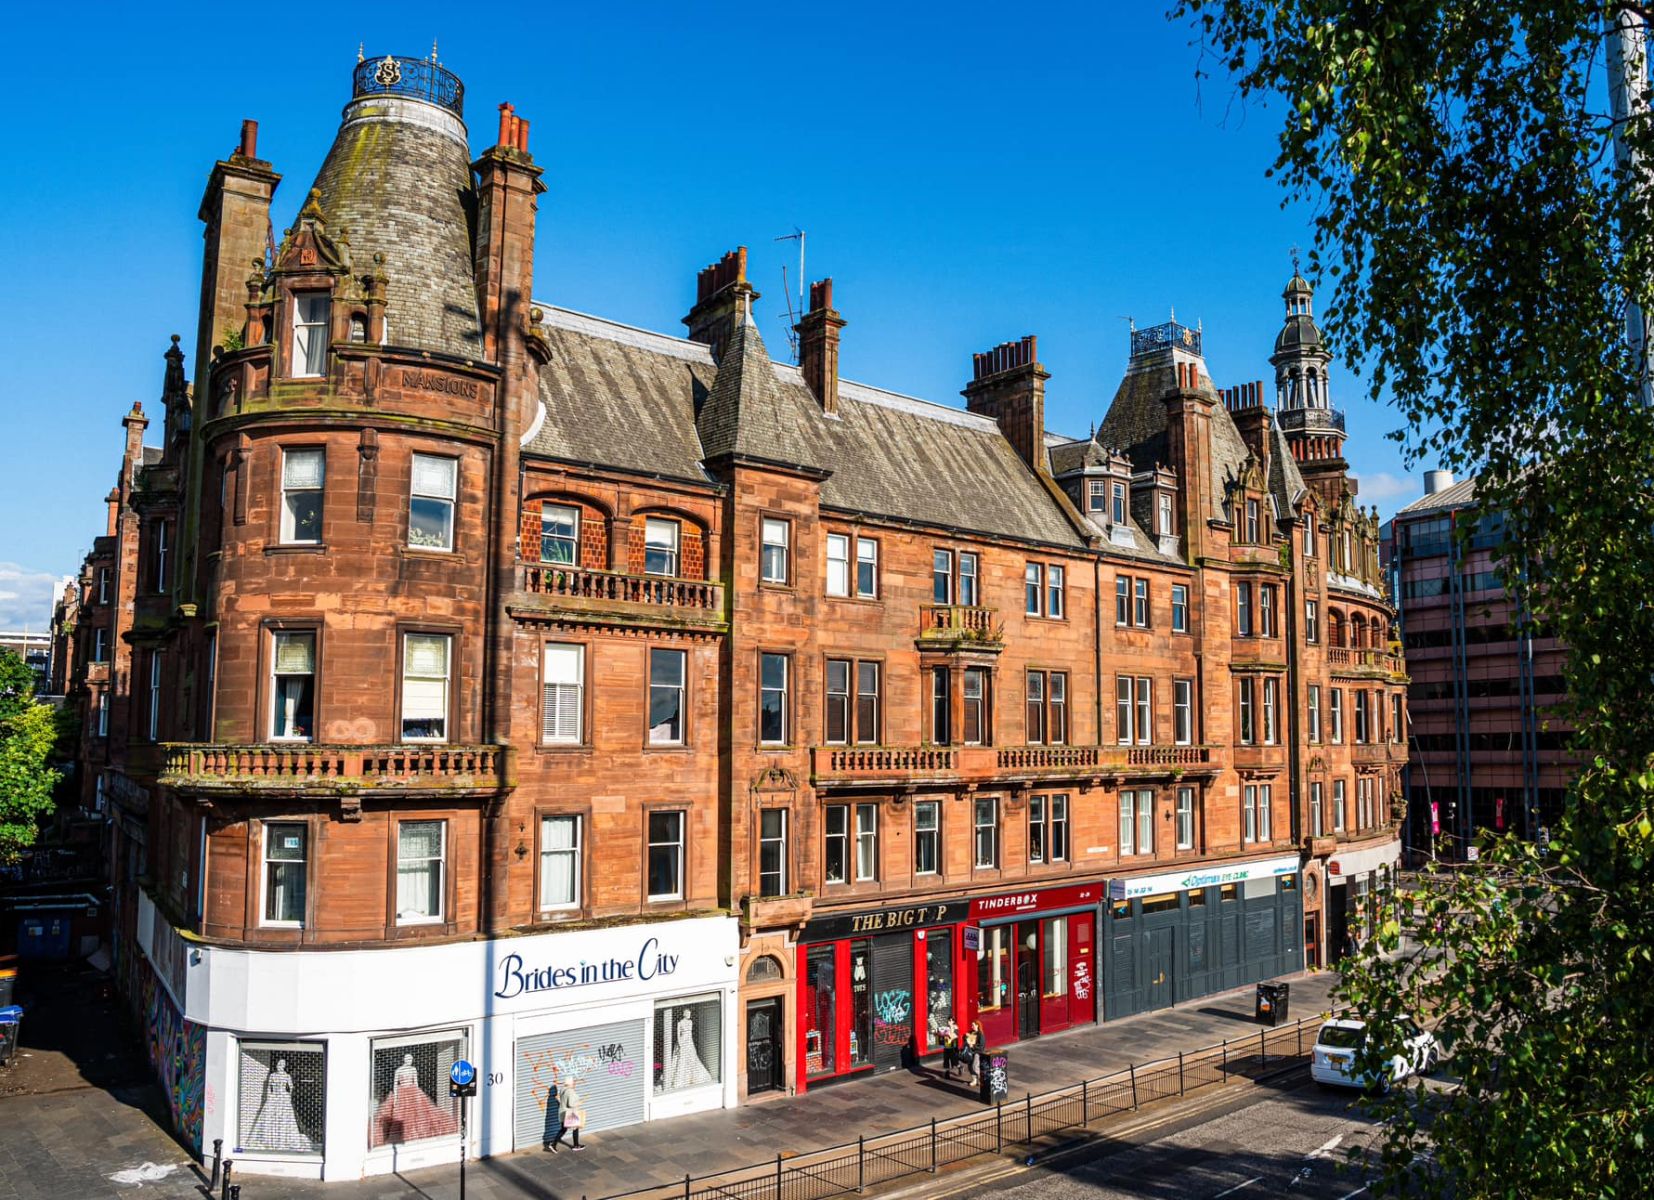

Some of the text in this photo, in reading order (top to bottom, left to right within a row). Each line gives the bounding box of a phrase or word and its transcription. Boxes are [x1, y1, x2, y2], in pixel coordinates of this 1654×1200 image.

[383, 64, 394, 79] S
[402, 369, 478, 399] MANSIONS
[978, 893, 1038, 910] TINDERBOX
[852, 913, 884, 932] THE
[886, 909, 914, 928] BIG
[494, 937, 679, 998] Brides in the City
[487, 1072, 504, 1087] 30
